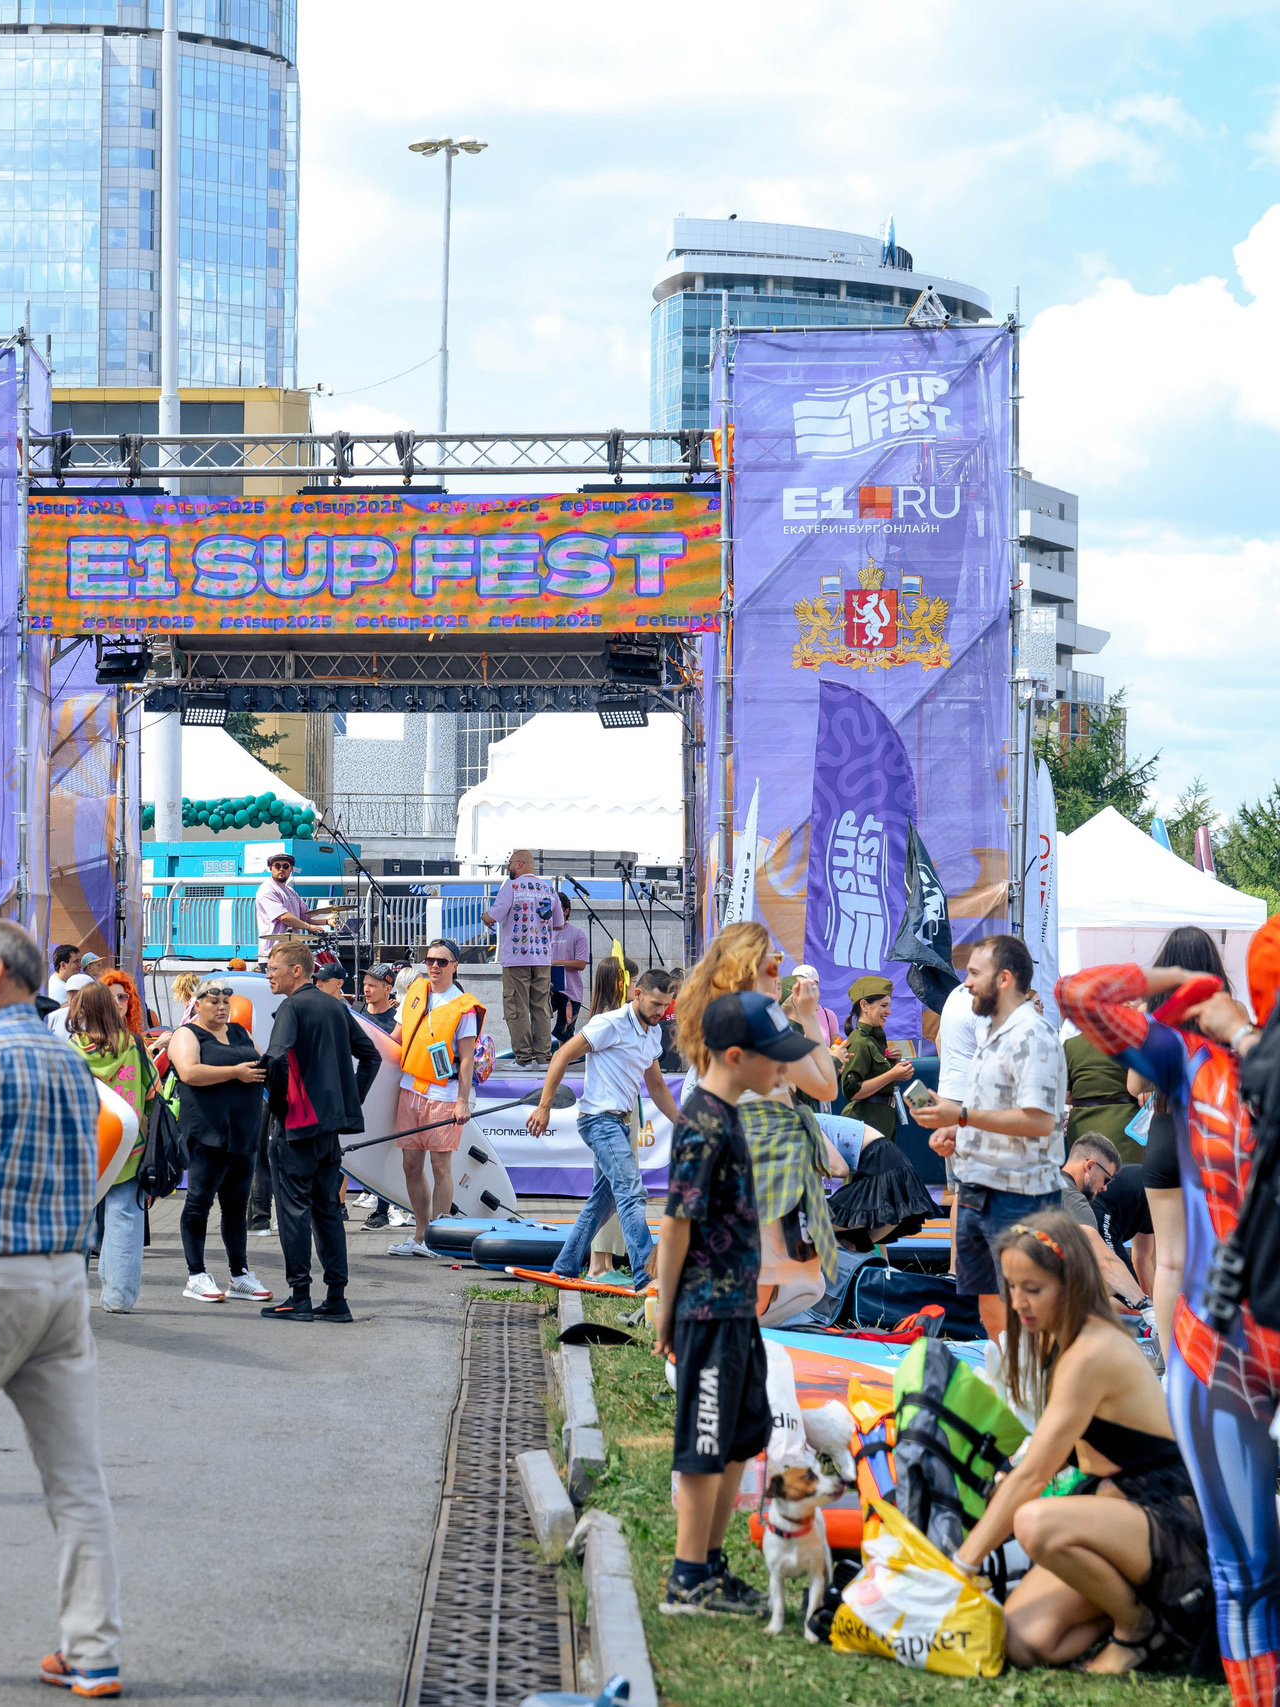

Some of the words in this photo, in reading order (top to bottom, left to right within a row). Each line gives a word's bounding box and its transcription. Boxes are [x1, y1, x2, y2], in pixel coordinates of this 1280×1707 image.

[793, 393, 868, 455] E1
[867, 376, 950, 409] SUP
[871, 402, 952, 440] FEST
[28, 500, 125, 517] e1sup2025
[153, 500, 265, 517] #e1sup2025
[290, 500, 403, 516] #e1sup2025
[560, 498, 675, 514] #e1sup2025
[782, 487, 853, 520] E1
[897, 487, 961, 519] RU
[783, 524, 881, 535] ЕКАТЕРИНБУРГ
[883, 522, 940, 534] ОНЛАЙН
[67, 535, 180, 600] E1
[192, 533, 398, 599] SUP
[411, 532, 688, 599] FEST
[83, 615, 195, 631] #e1sup2025
[220, 614, 333, 631] #e1sup2025
[356, 614, 468, 631] #e1sup2025
[489, 614, 602, 630] #e1sup2025
[635, 613, 721, 629] #e1sup20
[833, 809, 860, 890] SUP
[853, 814, 884, 899] FEST
[696, 1366, 720, 1456] WHITE
